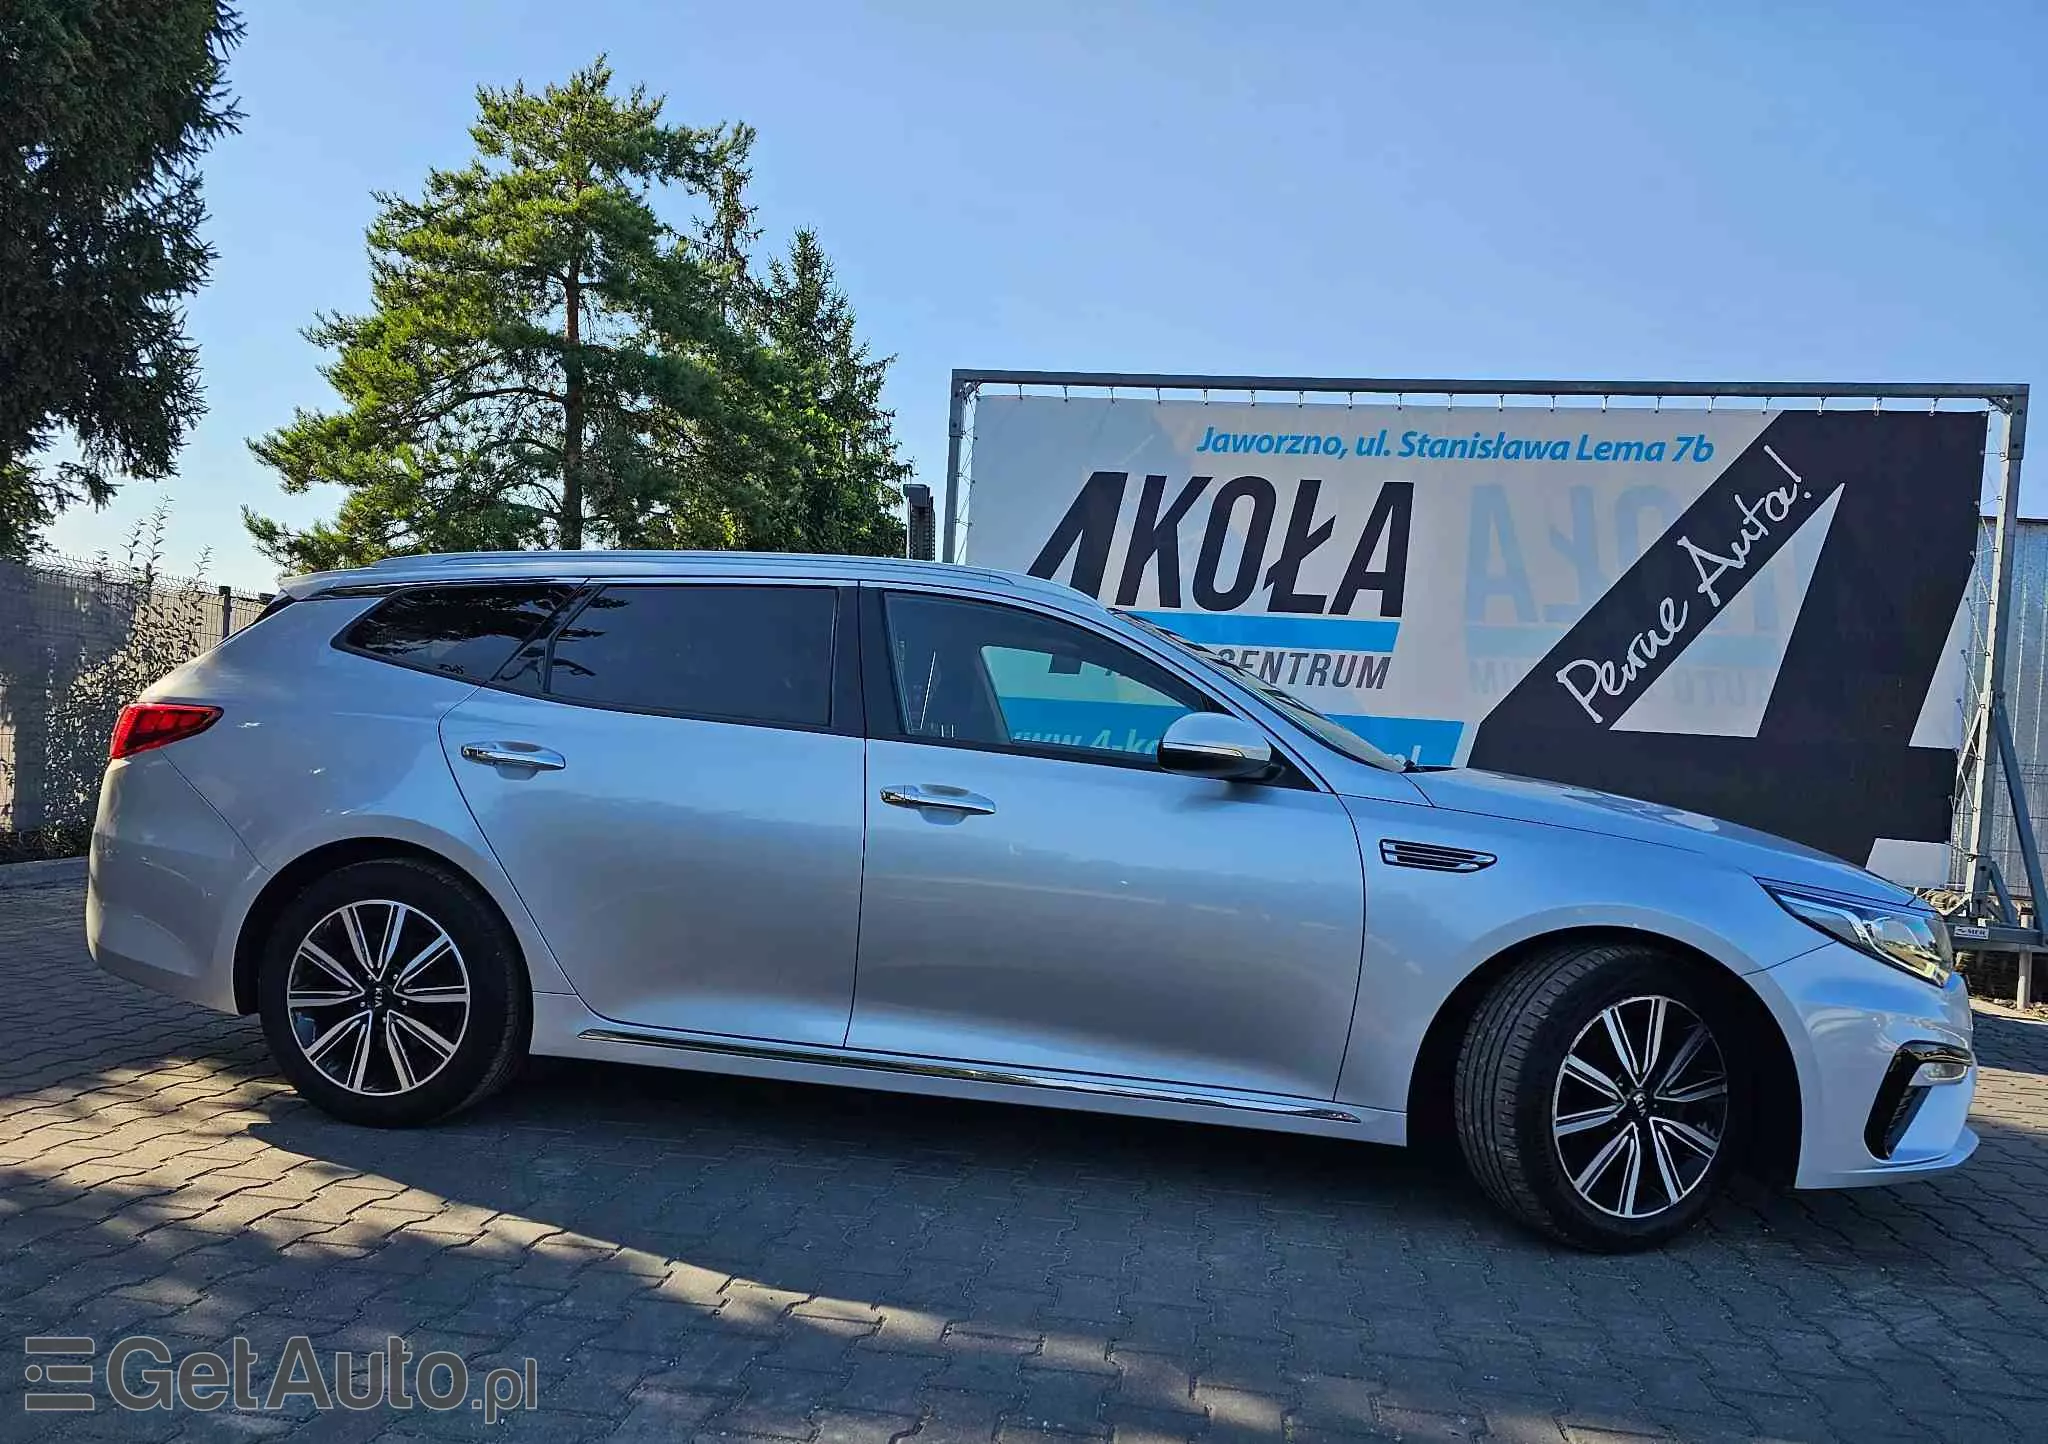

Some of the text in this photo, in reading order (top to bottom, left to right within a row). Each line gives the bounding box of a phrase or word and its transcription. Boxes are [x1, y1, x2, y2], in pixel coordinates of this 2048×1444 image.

[1196, 427, 1715, 463] Jaworzno, ul. Stanisława Lema 7b
